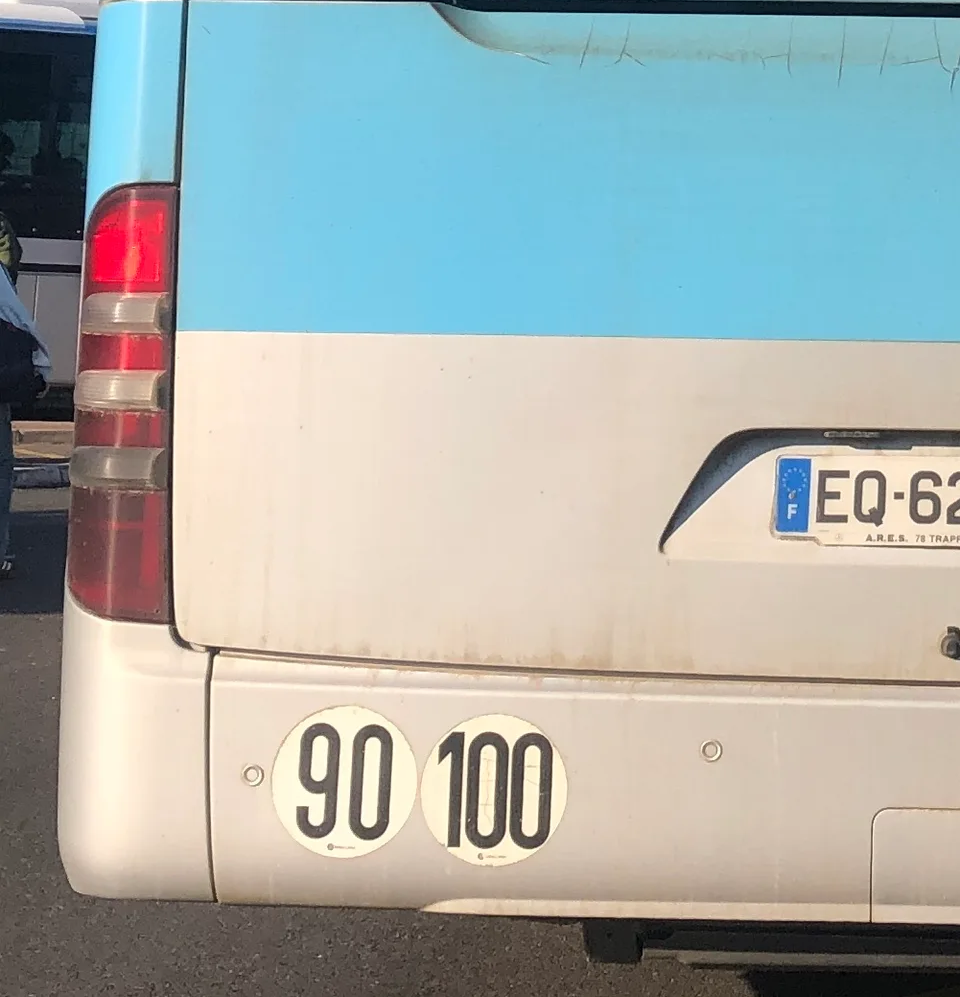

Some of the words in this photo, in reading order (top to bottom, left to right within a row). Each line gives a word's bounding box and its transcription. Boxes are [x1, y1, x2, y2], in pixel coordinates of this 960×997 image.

[787, 503, 798, 519] F
[915, 534, 926, 543] 78
[296, 722, 394, 840] 90
[438, 731, 554, 849] 100
